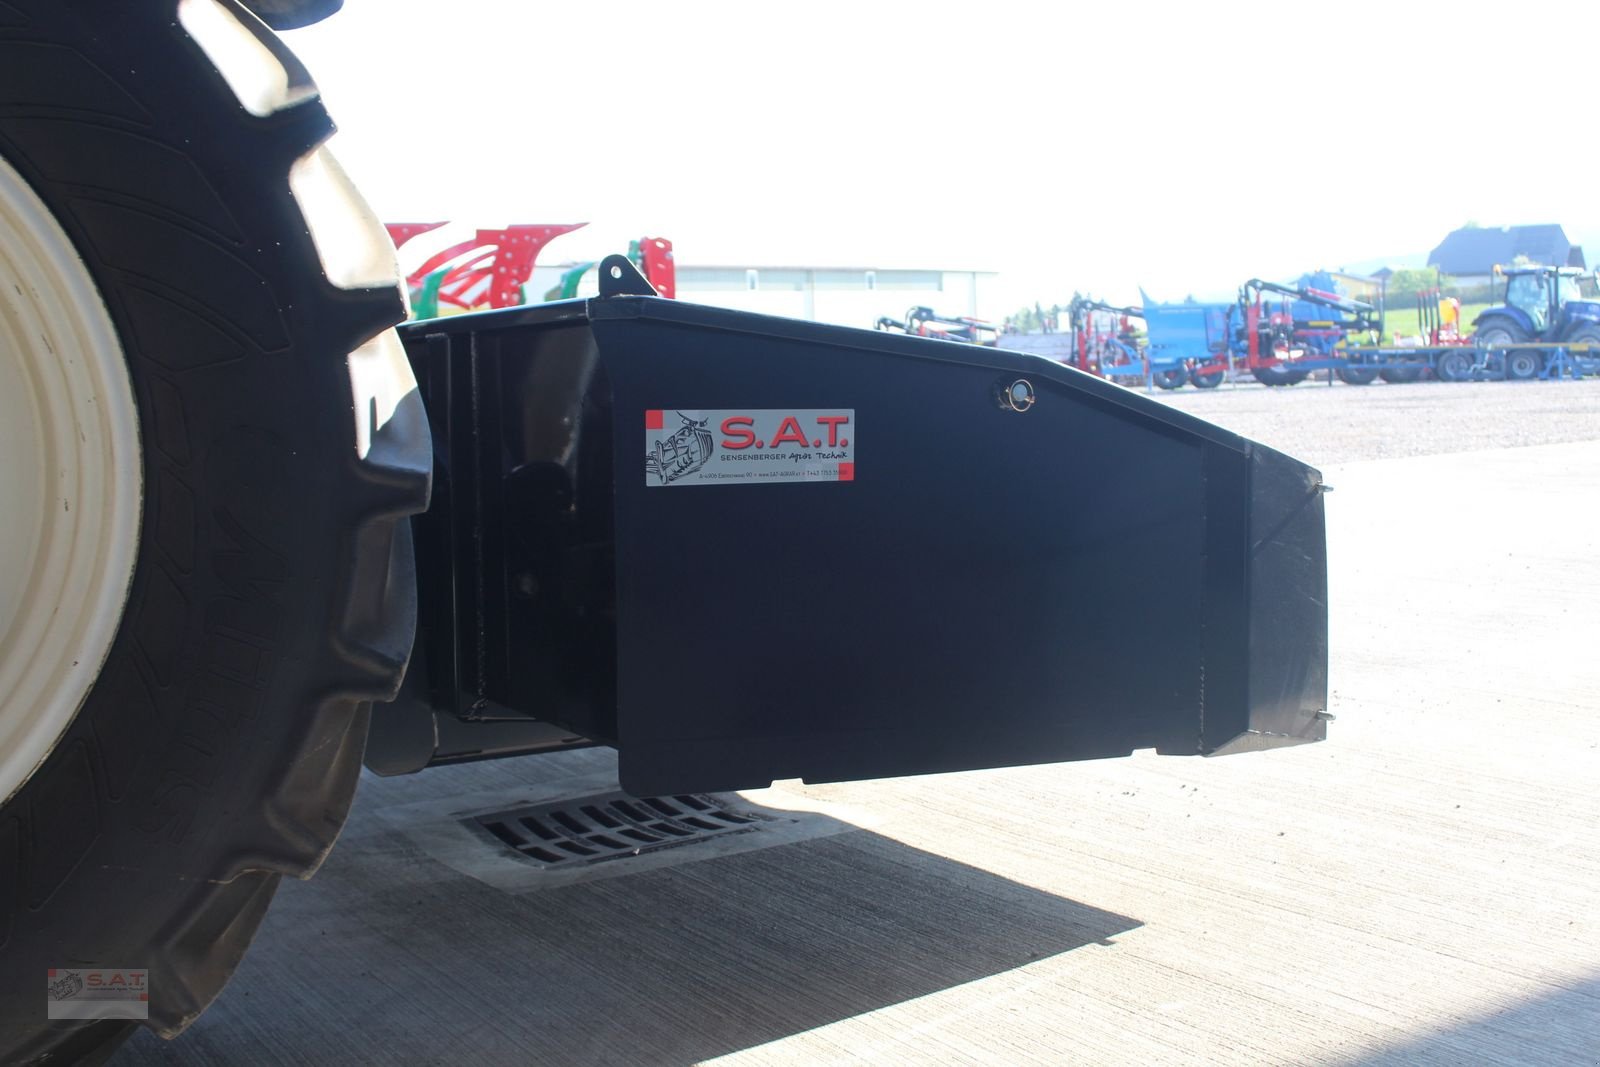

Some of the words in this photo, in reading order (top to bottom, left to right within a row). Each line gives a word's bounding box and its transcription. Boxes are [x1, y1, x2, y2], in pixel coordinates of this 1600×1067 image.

[720, 416, 849, 450] S.A.T.
[788, 452, 812, 463] Agrar
[815, 452, 848, 460] Technik
